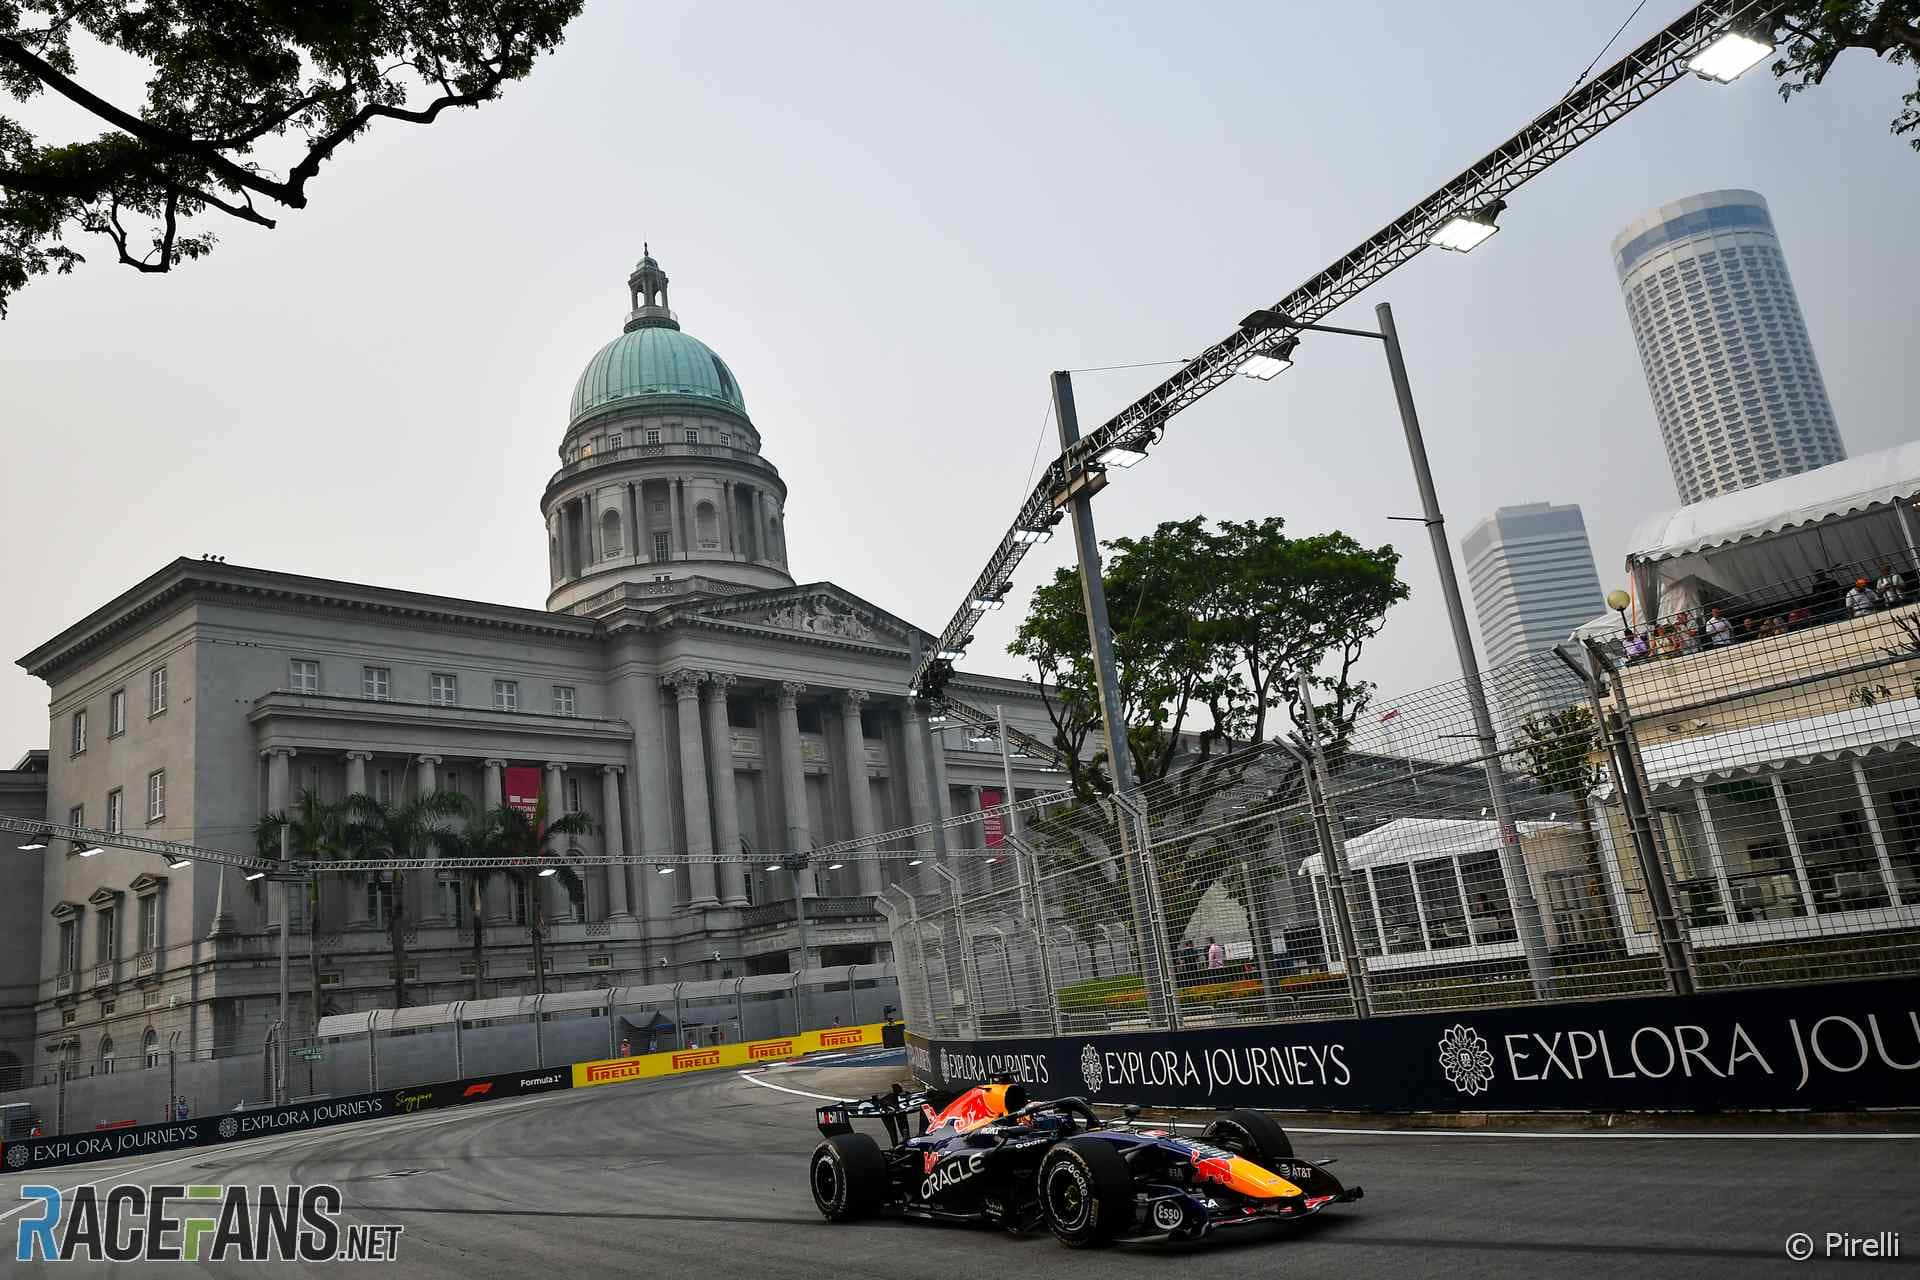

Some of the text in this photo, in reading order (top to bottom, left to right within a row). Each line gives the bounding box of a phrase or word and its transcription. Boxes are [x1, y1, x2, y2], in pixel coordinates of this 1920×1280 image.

[748, 1040, 793, 1059] PIRELLI
[820, 1029, 863, 1047] PIRELLI
[672, 1050, 720, 1070] PIRELLI
[1505, 1023, 1774, 1081] EXPLORA
[587, 1060, 640, 1082] PIRELLI
[949, 1054, 987, 1081] EXPLORA
[1106, 1043, 1351, 1096] EXPLORA JOURNEYS
[520, 1076, 553, 1087] Formula
[242, 1098, 383, 1132] EXPLORA JOURNEYS
[34, 1125, 198, 1161] EXPLORA JOURNEYS
[921, 1152, 985, 1199] ORACLE
[1292, 1167, 1313, 1179] AT&T
